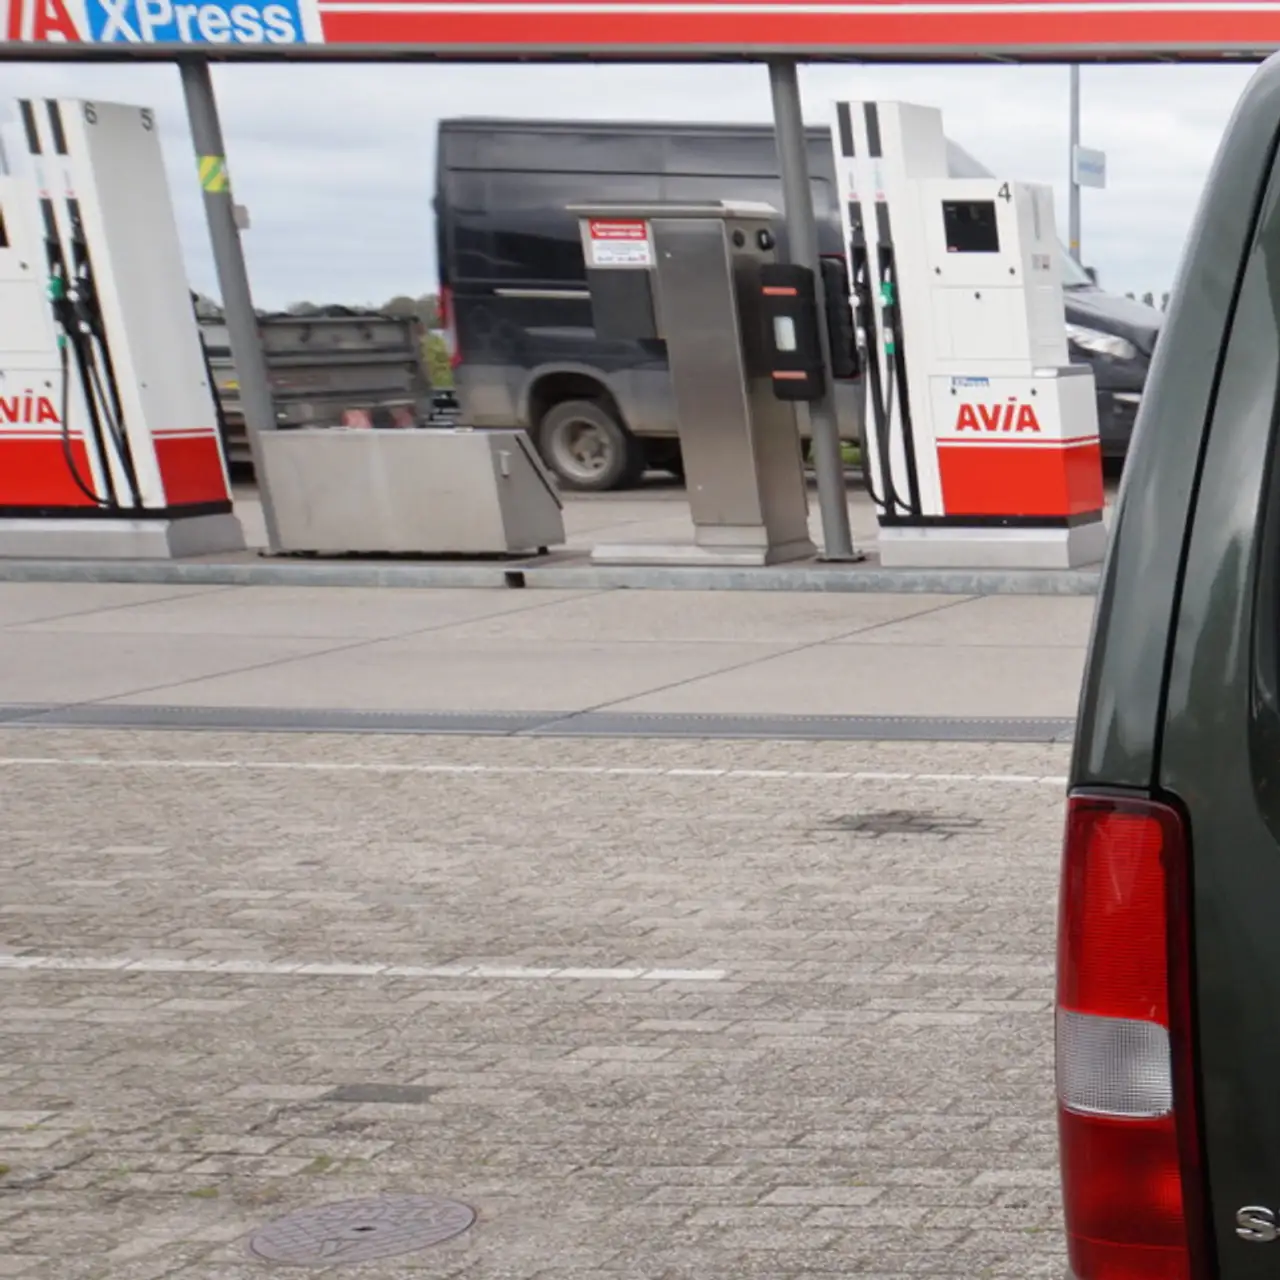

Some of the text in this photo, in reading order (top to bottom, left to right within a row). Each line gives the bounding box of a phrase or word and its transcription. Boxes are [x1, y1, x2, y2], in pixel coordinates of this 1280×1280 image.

[998, 181, 1012, 204] 4
[0, 388, 61, 423] VIA
[956, 396, 1041, 432] AVIA
